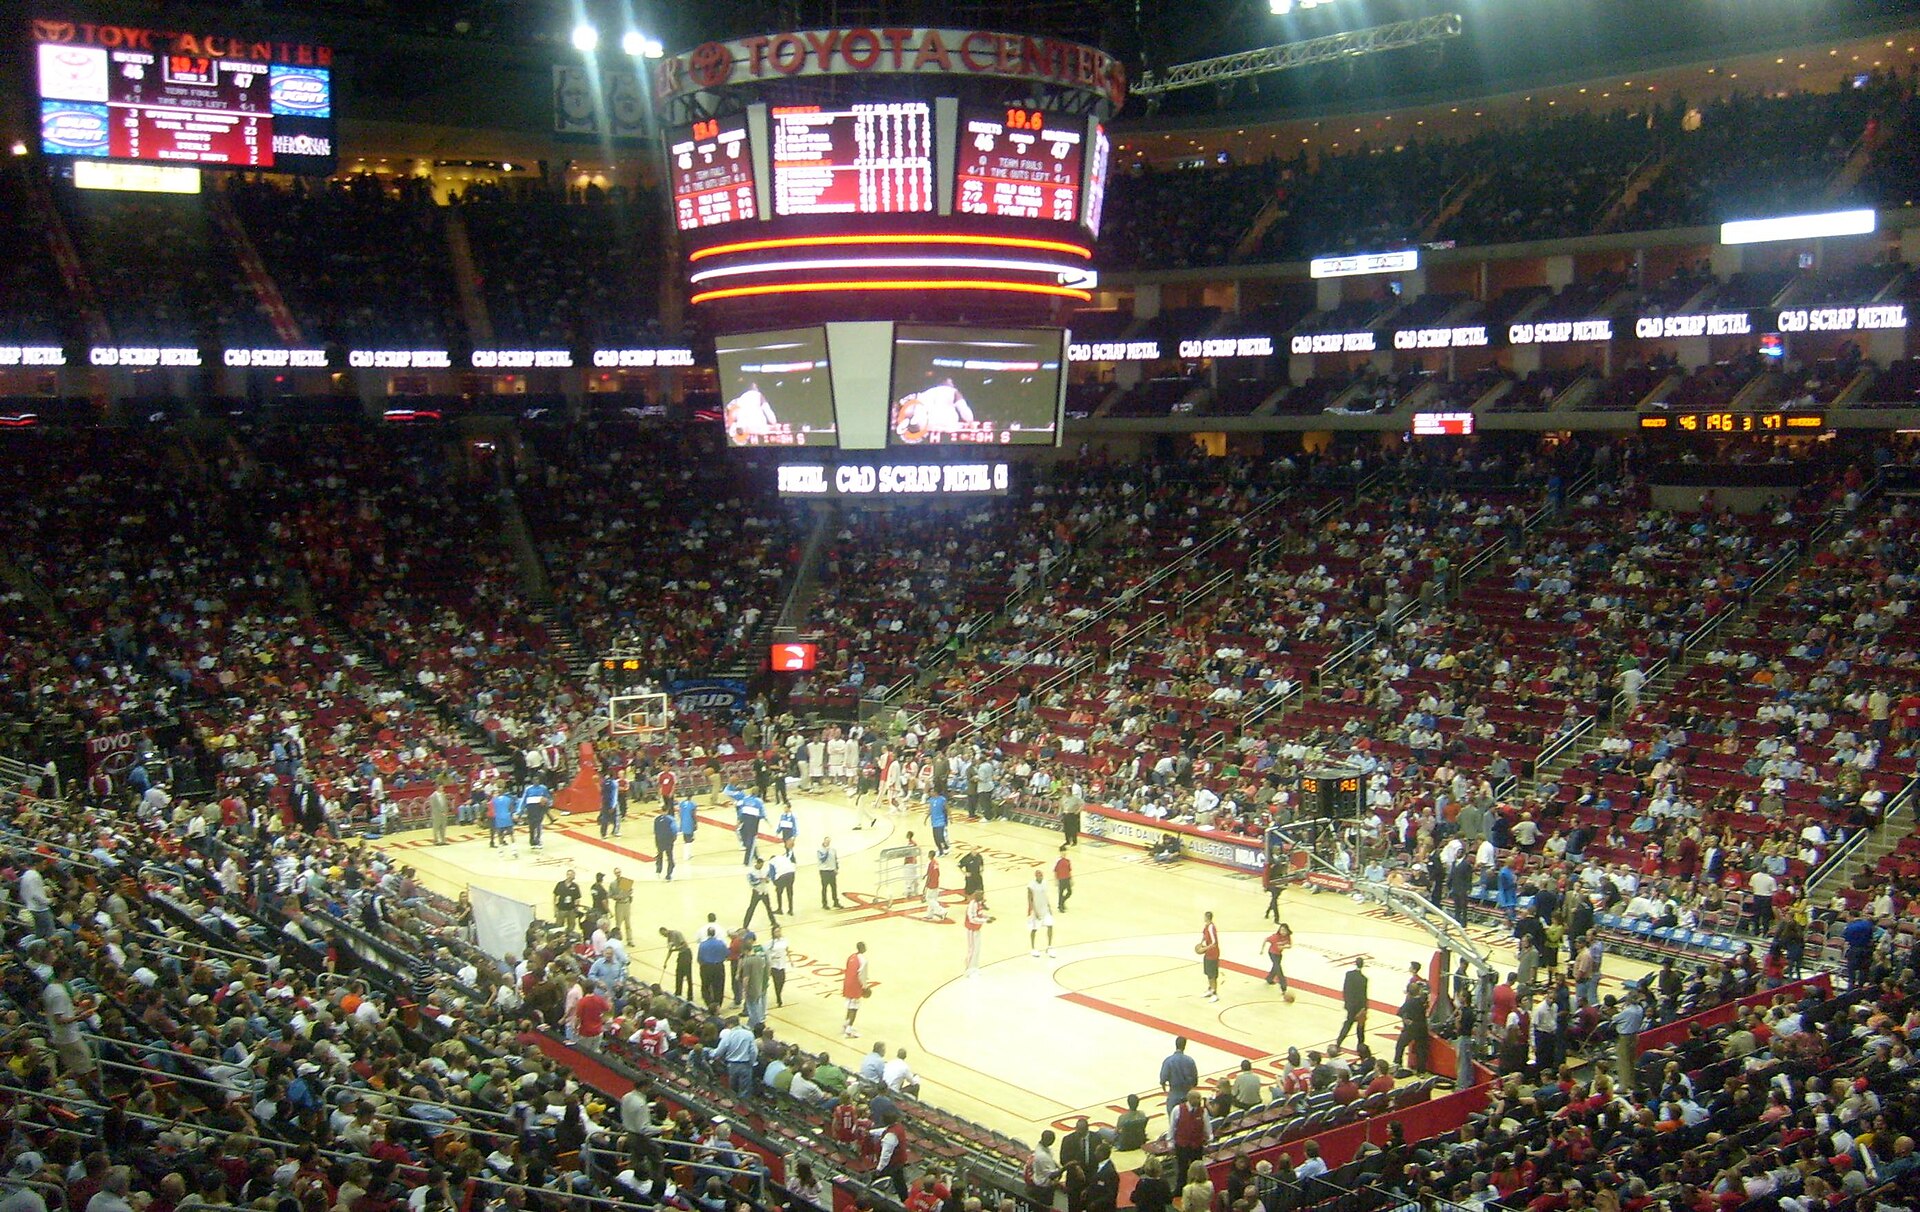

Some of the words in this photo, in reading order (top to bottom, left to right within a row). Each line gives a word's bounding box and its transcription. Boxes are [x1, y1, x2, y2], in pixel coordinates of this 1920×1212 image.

[741, 27, 952, 77] TOYOTA
[961, 31, 1107, 89] CENTER
[235, 74, 253, 87] 47
[282, 79, 324, 92] BUD
[270, 92, 329, 103] LIGHT
[1006, 109, 1043, 131] 19.6
[272, 134, 331, 148] MEMORIAL
[273, 143, 331, 156] HERMANN
[974, 134, 994, 151] 46
[1051, 142, 1070, 159] 47
[1664, 315, 1707, 337] SCRAP
[1706, 313, 1751, 335] METAL
[1778, 311, 1808, 332] C&D
[1809, 308, 1857, 331] SCRAP
[1857, 305, 1907, 329] METAL
[1417, 328, 1451, 348] SCRAP
[1451, 326, 1488, 347] METAL
[1534, 322, 1573, 343] SCRAP
[1572, 320, 1612, 341] METAL
[1092, 343, 1127, 360] SCRAP
[1127, 342, 1160, 360] METAL
[1202, 339, 1237, 357] SCRAP
[1237, 337, 1273, 356] METAL
[1313, 334, 1344, 353] SCRAP
[1343, 332, 1376, 351] METAL
[1679, 415, 1696, 430] 46
[1743, 417, 1752, 431] 3
[1762, 414, 1781, 429] 47
[836, 465, 876, 493] C&D
[879, 465, 941, 493] SCRAP
[943, 464, 991, 491] METAL
[1112, 824, 1133, 836] VOTE
[1136, 828, 1160, 842] DAILY
